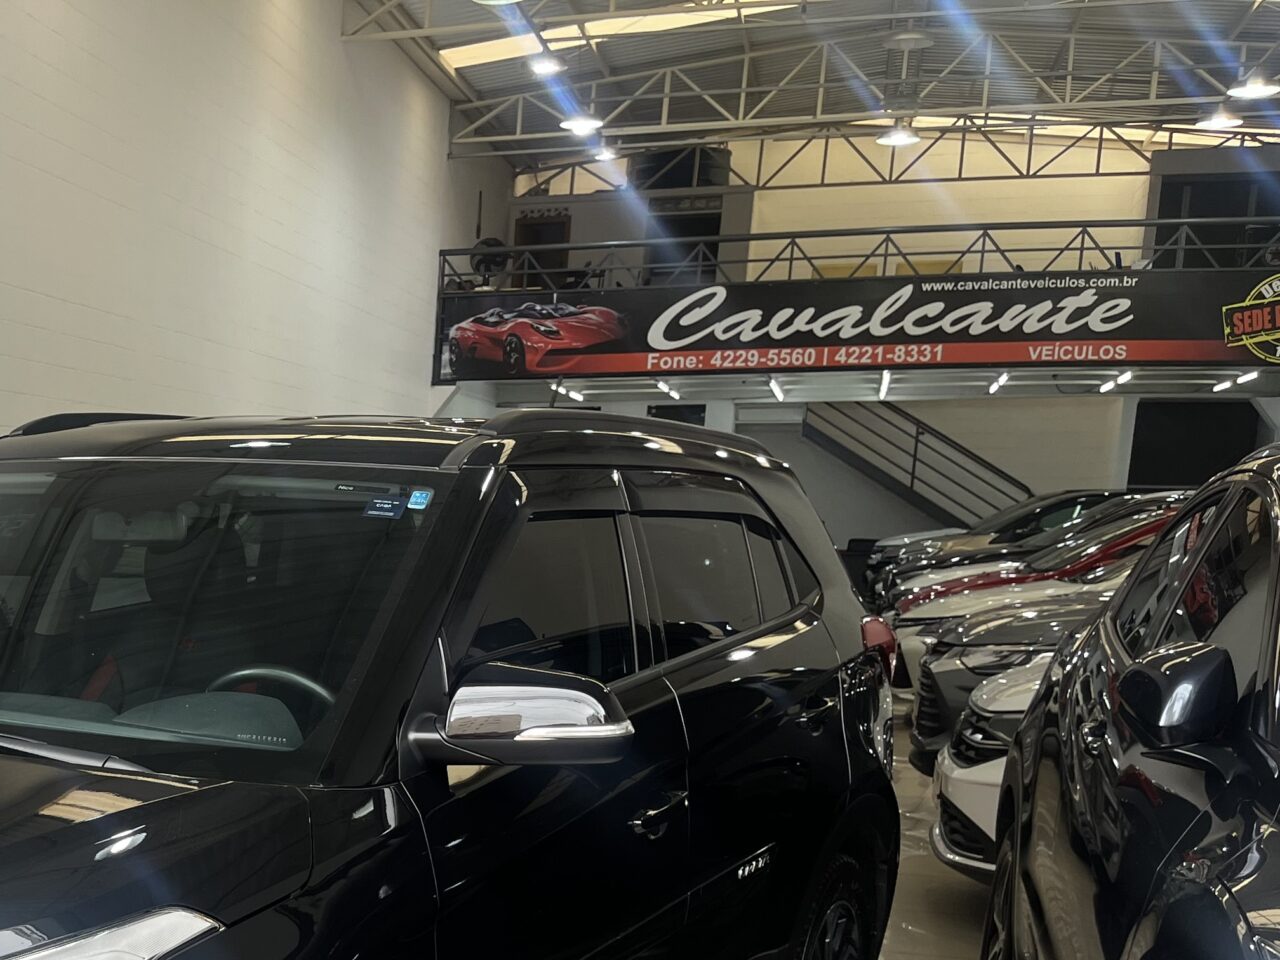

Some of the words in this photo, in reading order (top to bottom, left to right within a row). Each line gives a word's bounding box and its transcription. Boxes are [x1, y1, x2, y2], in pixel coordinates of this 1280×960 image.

[921, 275, 1139, 291] www.cavalcanteveiculos.com.br
[646, 283, 1134, 351] Cavalcante
[1232, 307, 1272, 335] SEDE
[646, 353, 704, 370] Fone:
[710, 347, 816, 369] 4229-5560
[834, 344, 944, 365] 4221-8331
[1028, 342, 1128, 361] VEÍCULOS
